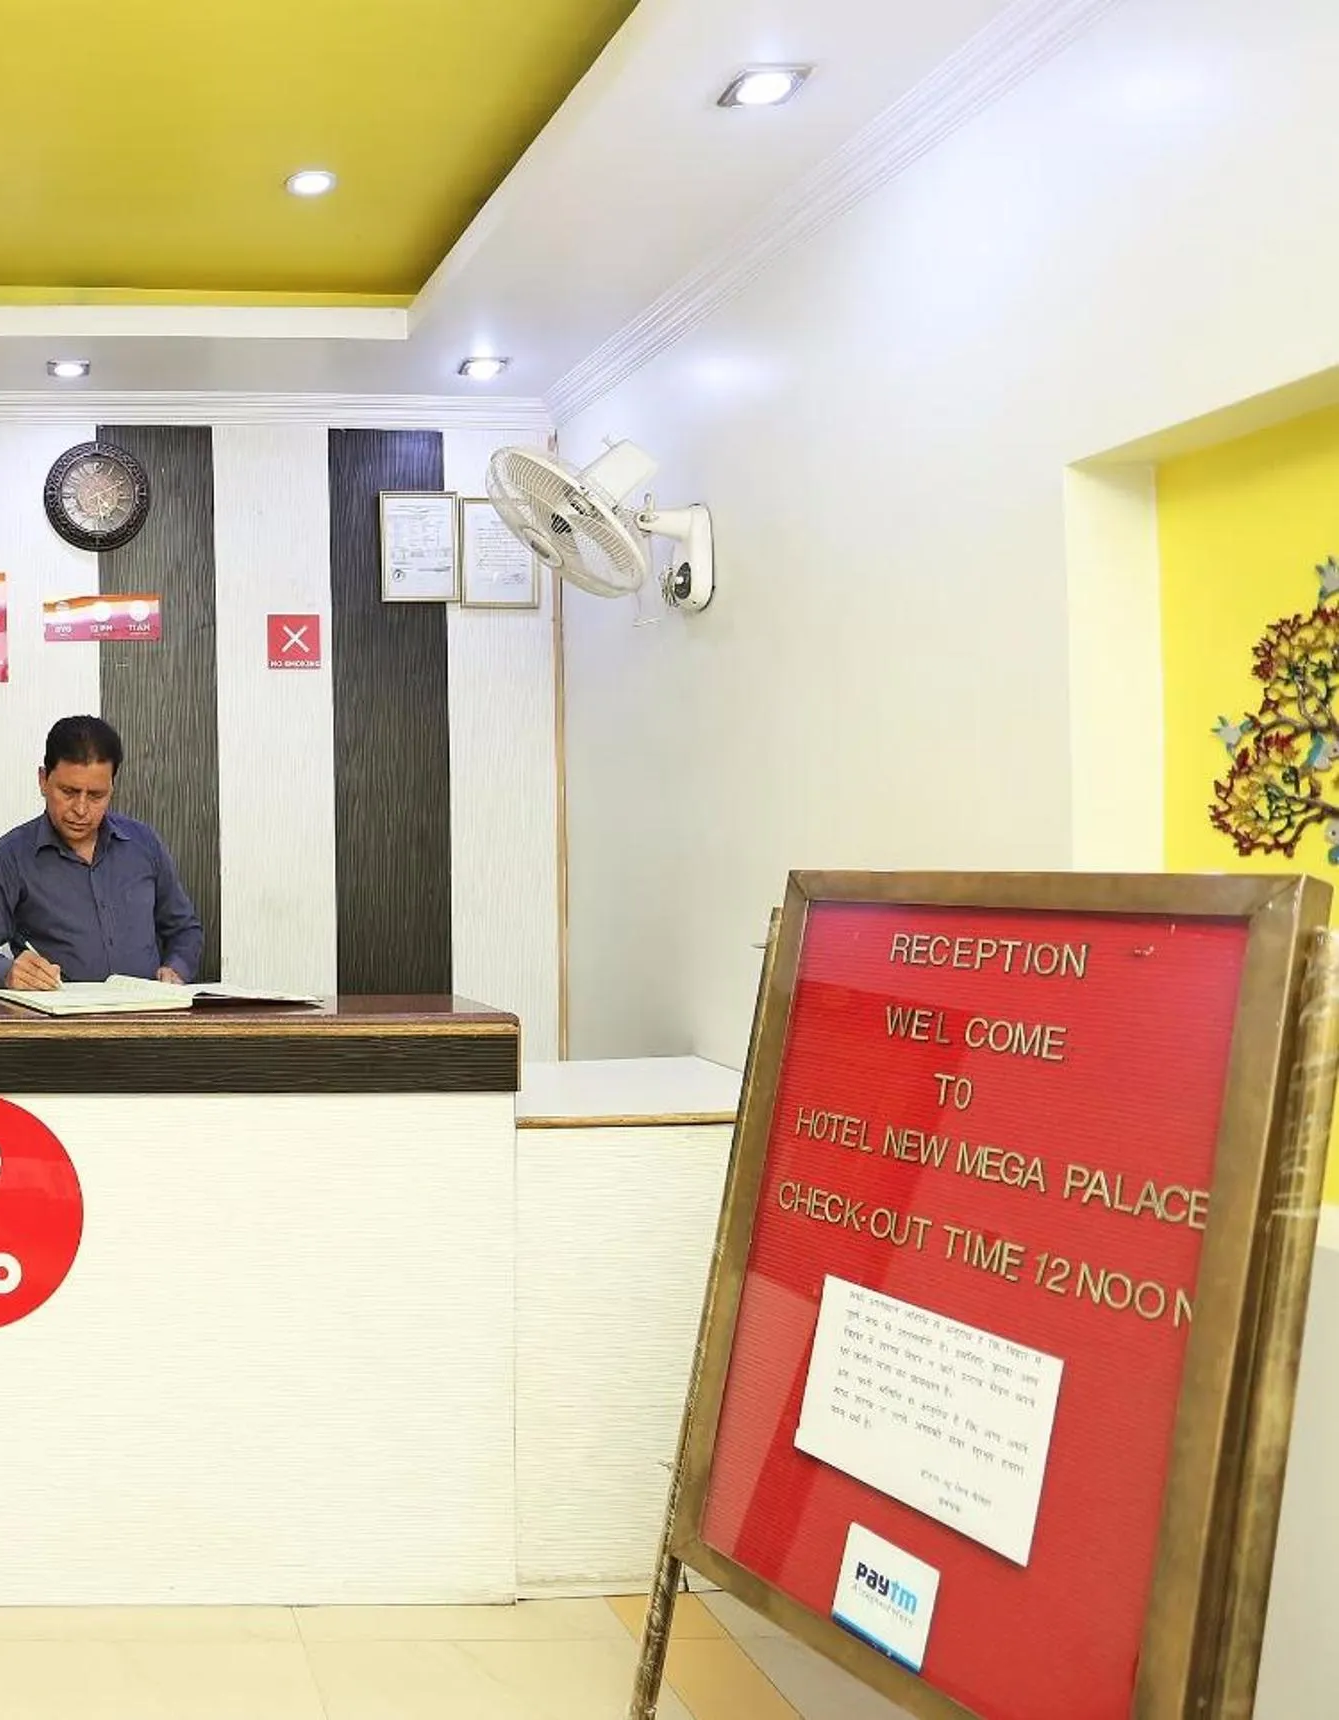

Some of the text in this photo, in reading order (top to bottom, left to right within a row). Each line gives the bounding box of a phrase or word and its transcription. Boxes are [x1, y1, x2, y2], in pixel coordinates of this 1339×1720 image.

[889, 932, 1089, 978] RECEPTION
[933, 1073, 973, 1109] TO
[795, 1107, 1210, 1230] HOTEL NEW MEGA PALACE
[943, 1224, 1026, 1282] TIME
[1034, 1252, 1072, 1294] 12
[855, 1561, 917, 1615] paytm
